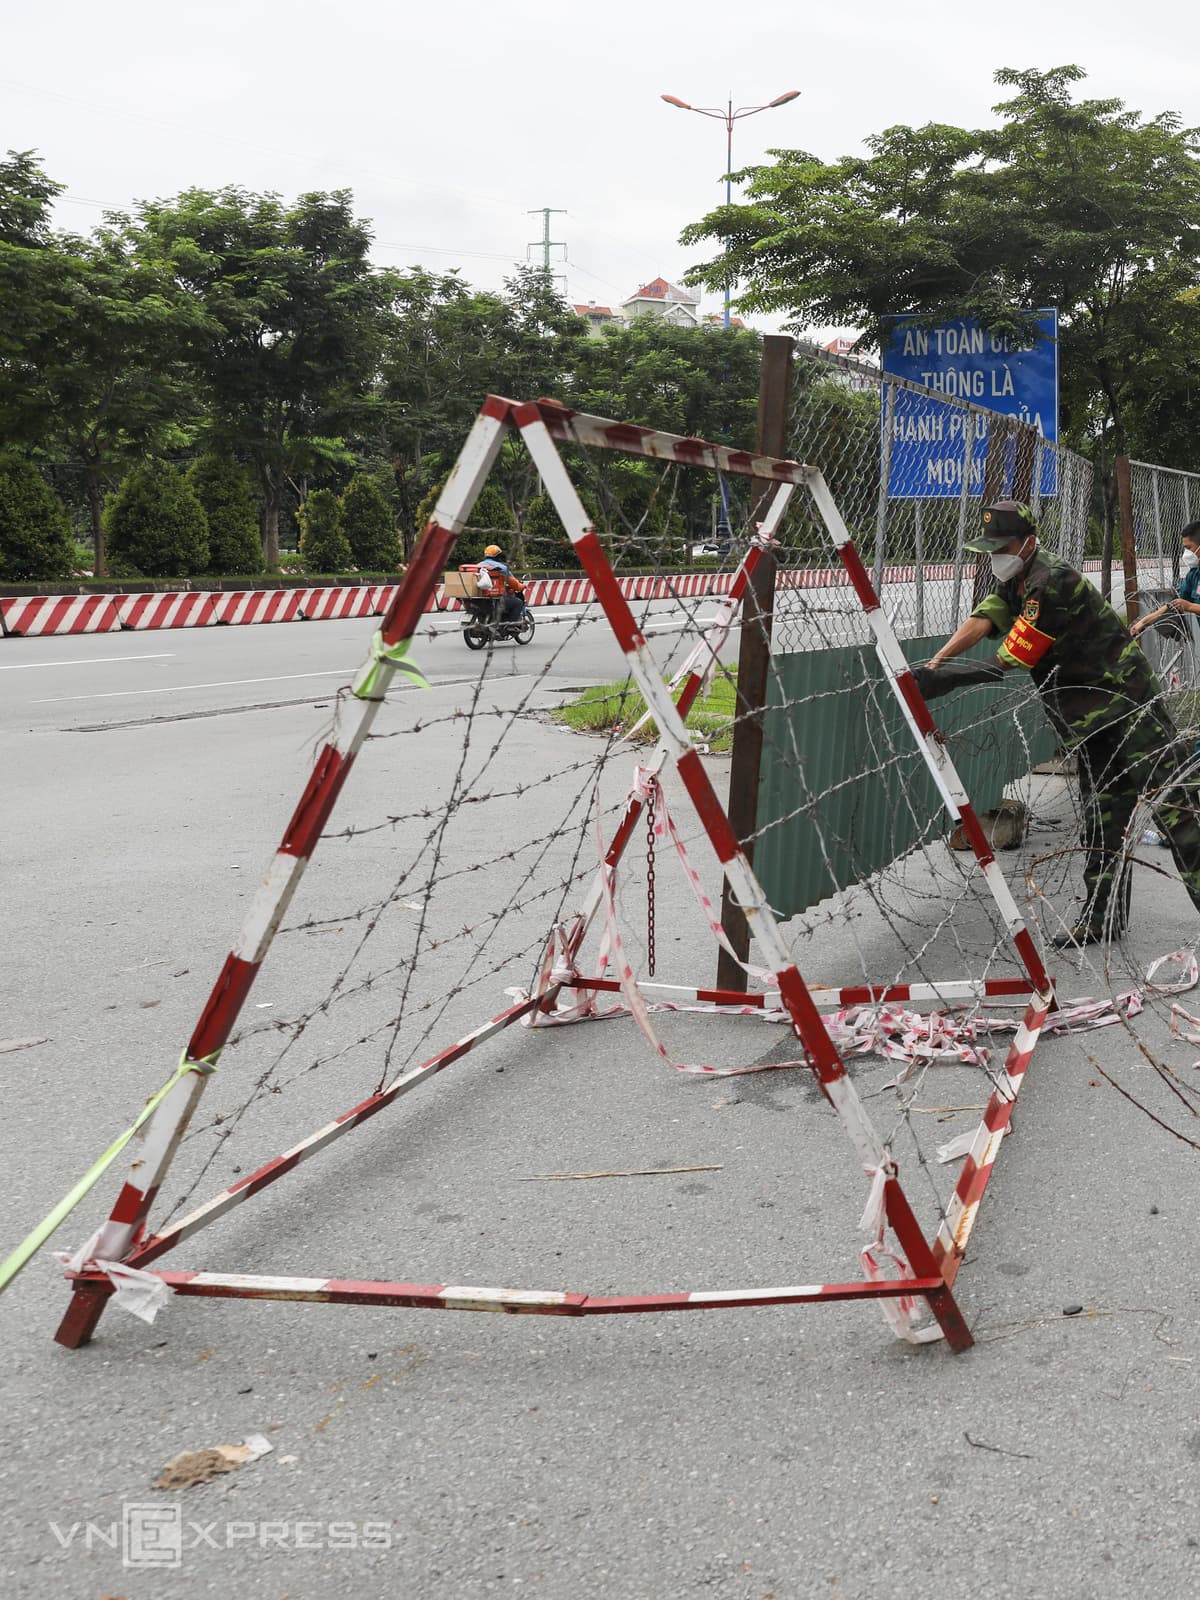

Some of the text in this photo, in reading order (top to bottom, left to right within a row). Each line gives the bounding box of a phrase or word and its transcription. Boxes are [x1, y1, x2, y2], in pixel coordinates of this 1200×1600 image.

[903, 330, 929, 357] AN
[934, 322, 984, 356] TOÀN
[920, 363, 1015, 398] THÔNG LÀ
